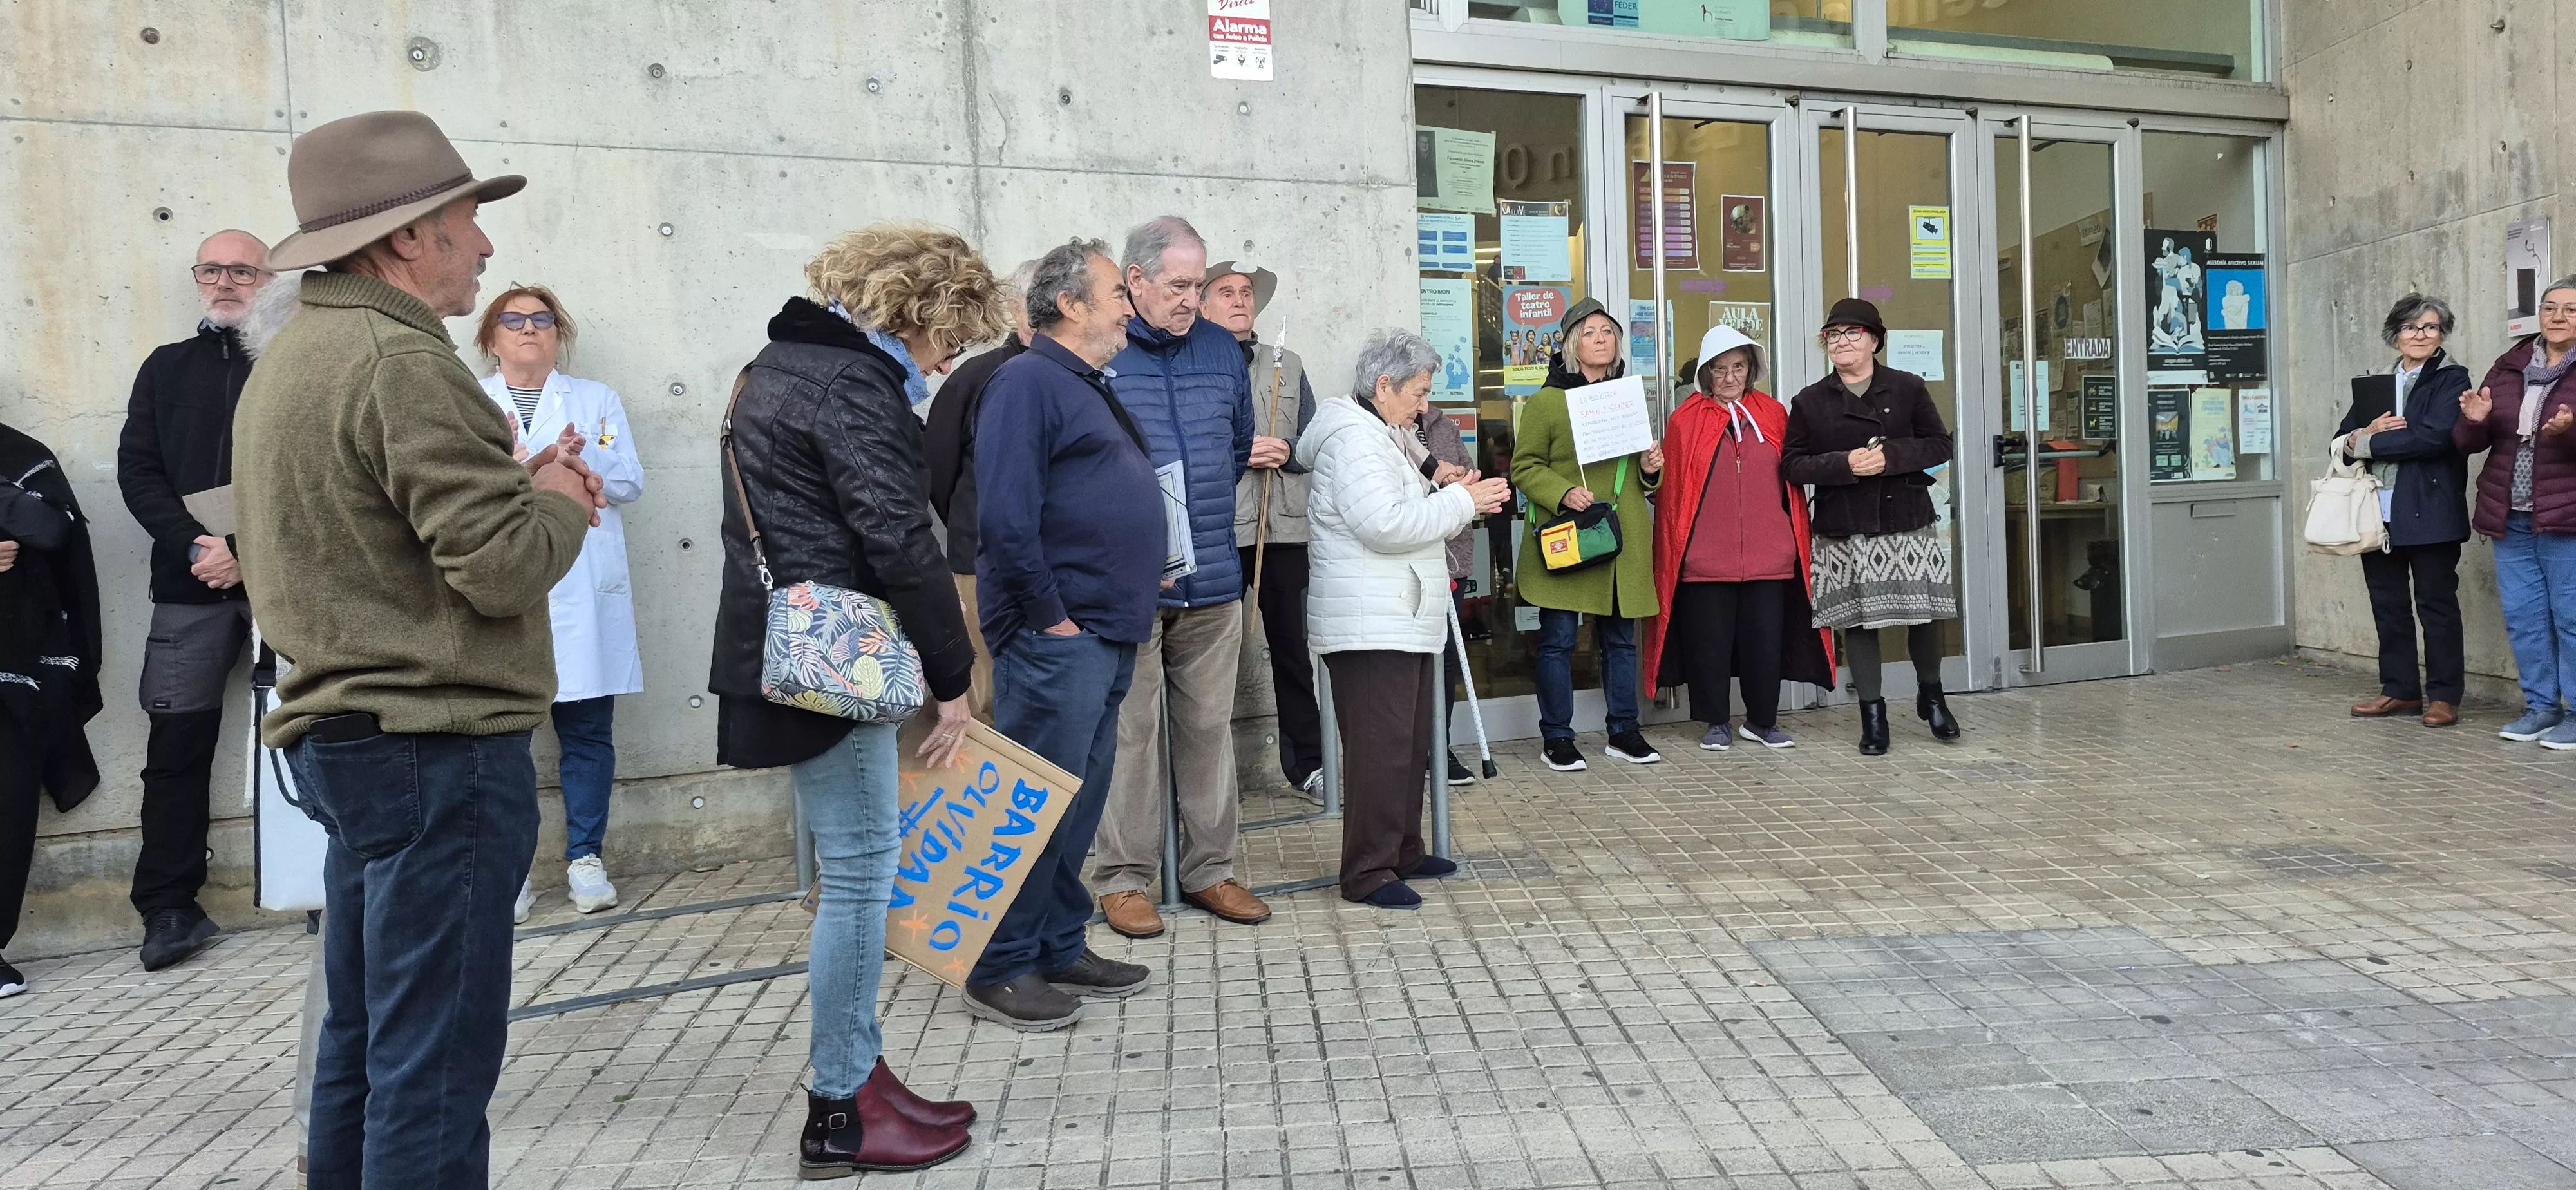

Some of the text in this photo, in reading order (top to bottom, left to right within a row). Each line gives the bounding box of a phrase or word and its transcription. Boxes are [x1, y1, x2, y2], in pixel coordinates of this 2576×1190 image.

[1615, 1, 1638, 10] FEDER
[1213, 18, 1267, 35] Alarma
[1515, 290, 1555, 301] Taller de
[1520, 301, 1550, 310] teatro
[1520, 308, 1553, 319] infantil
[1723, 307, 1759, 319] AULA
[2065, 338, 2110, 358] ENTRADA
[1579, 396, 1587, 404] LA
[929, 777, 1049, 951] BARRIO
